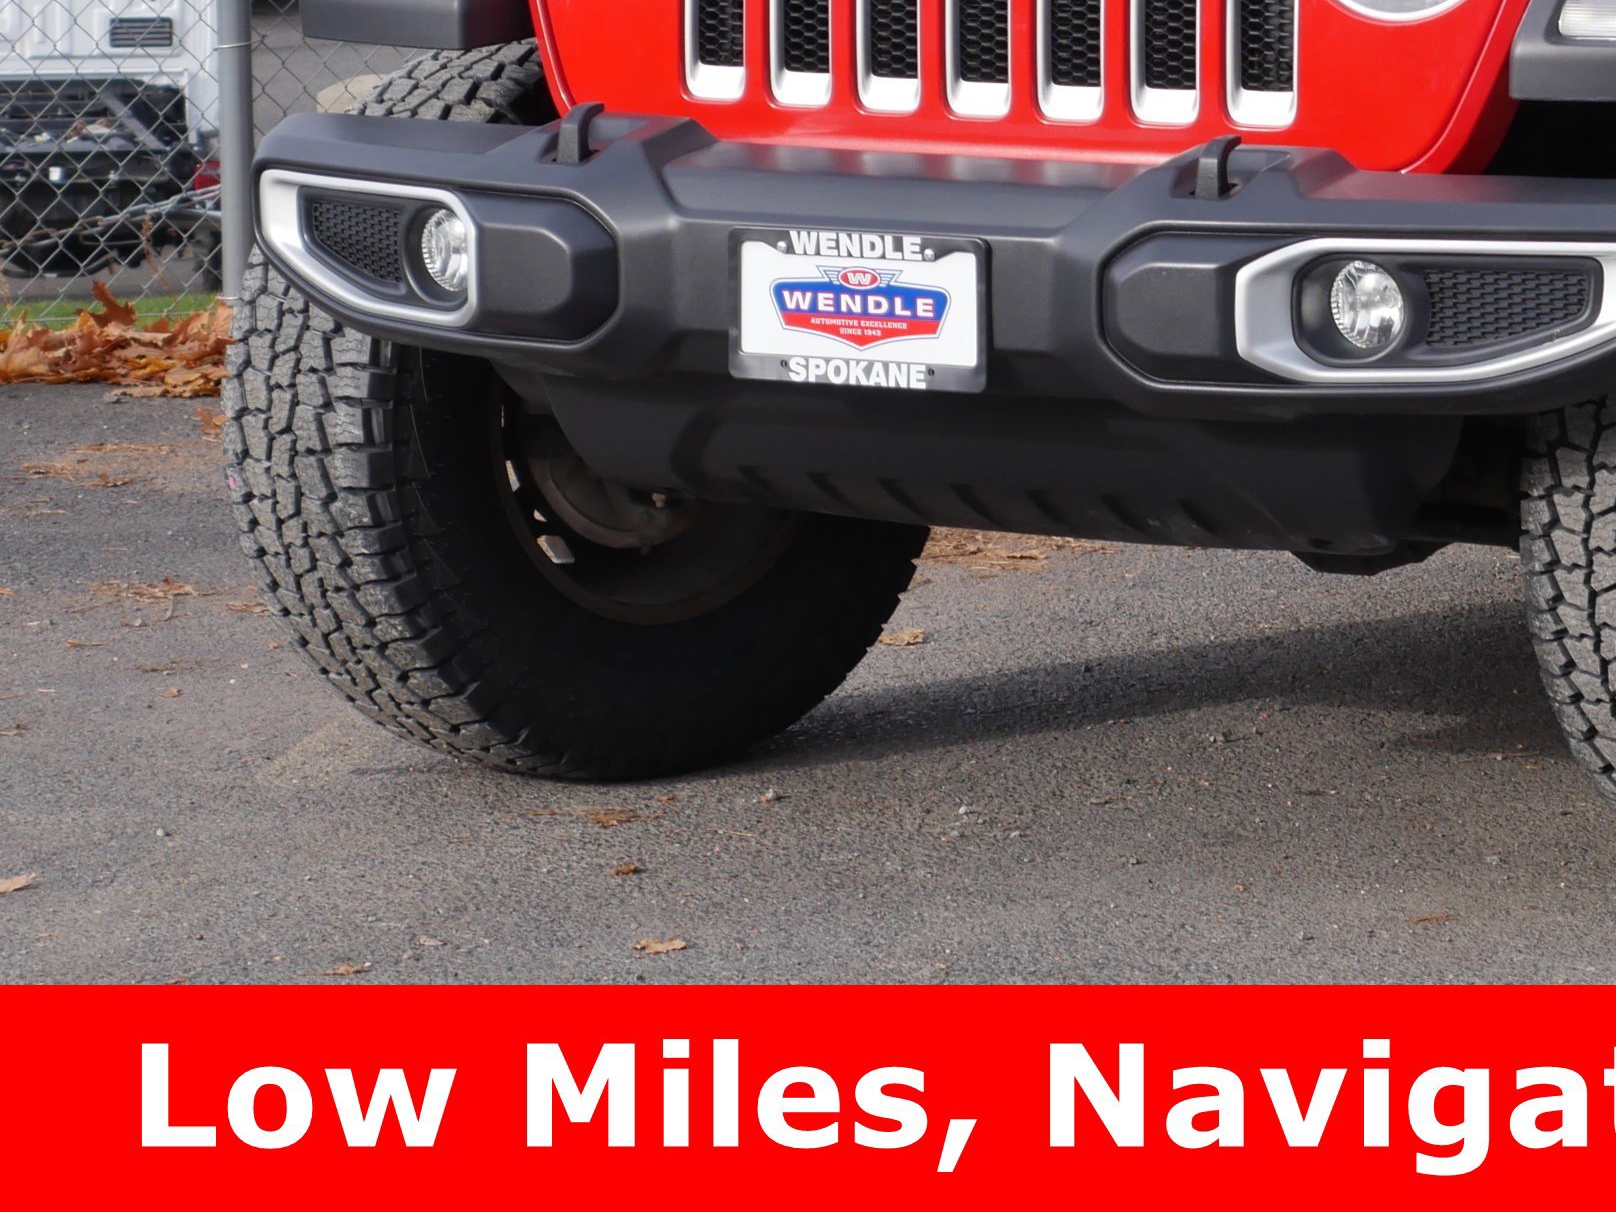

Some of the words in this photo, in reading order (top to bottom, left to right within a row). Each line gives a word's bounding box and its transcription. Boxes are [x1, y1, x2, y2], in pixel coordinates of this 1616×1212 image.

[789, 230, 922, 261] WENDLE
[782, 290, 934, 317] WENDLE
[810, 317, 859, 328] AUTOMOTIVE
[861, 320, 908, 329] EXCELLENCE
[840, 328, 862, 336] SINCE
[864, 328, 882, 336] 1943
[788, 356, 926, 389] SPOKANE
